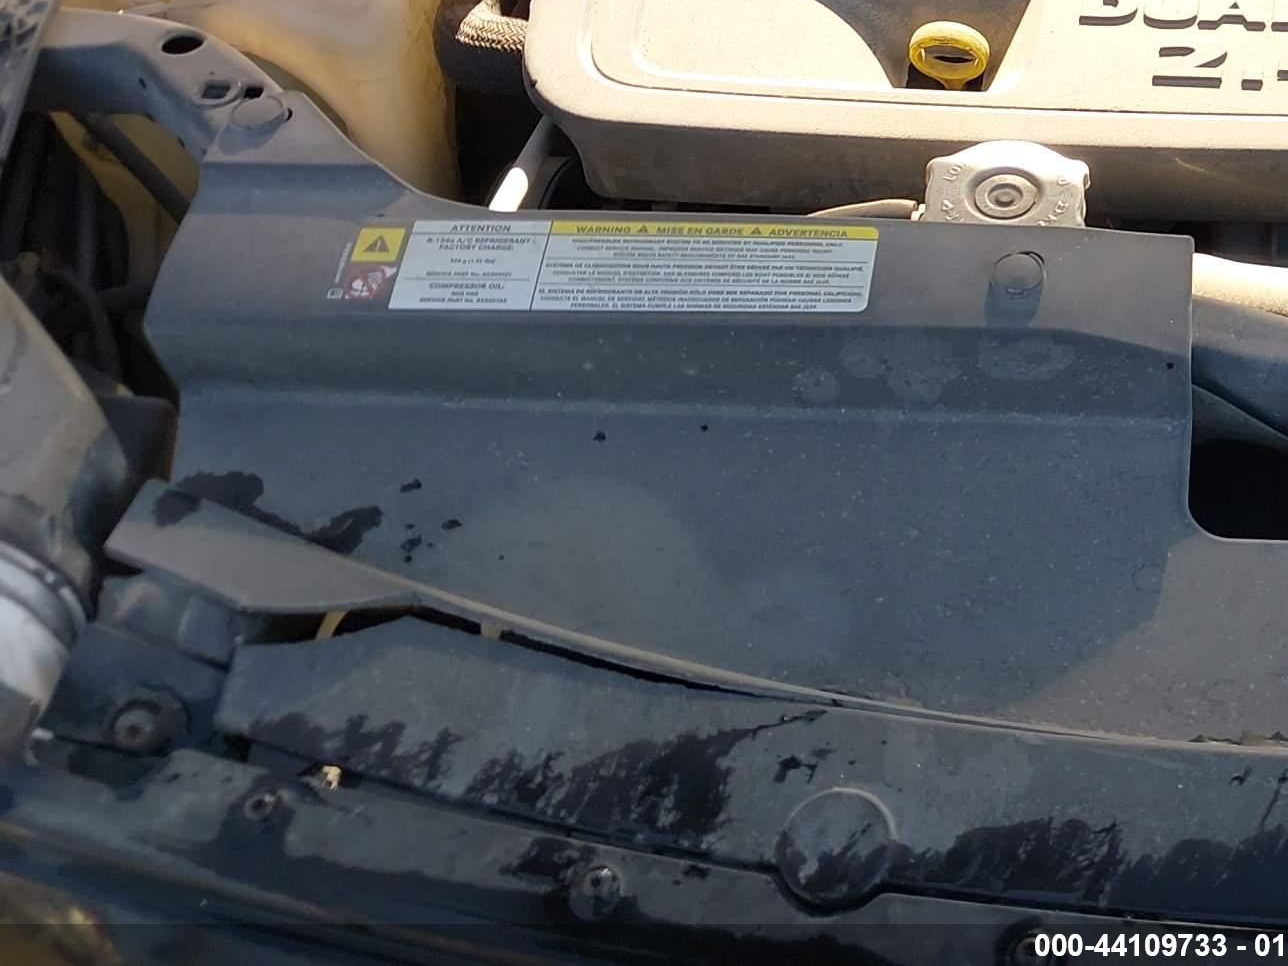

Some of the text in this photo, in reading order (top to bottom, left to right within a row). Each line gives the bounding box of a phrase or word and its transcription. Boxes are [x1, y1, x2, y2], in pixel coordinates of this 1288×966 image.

[451, 224, 512, 233] ATTENTION
[576, 225, 849, 238] WARNING MISE EN GARDE ADVERTENCIA
